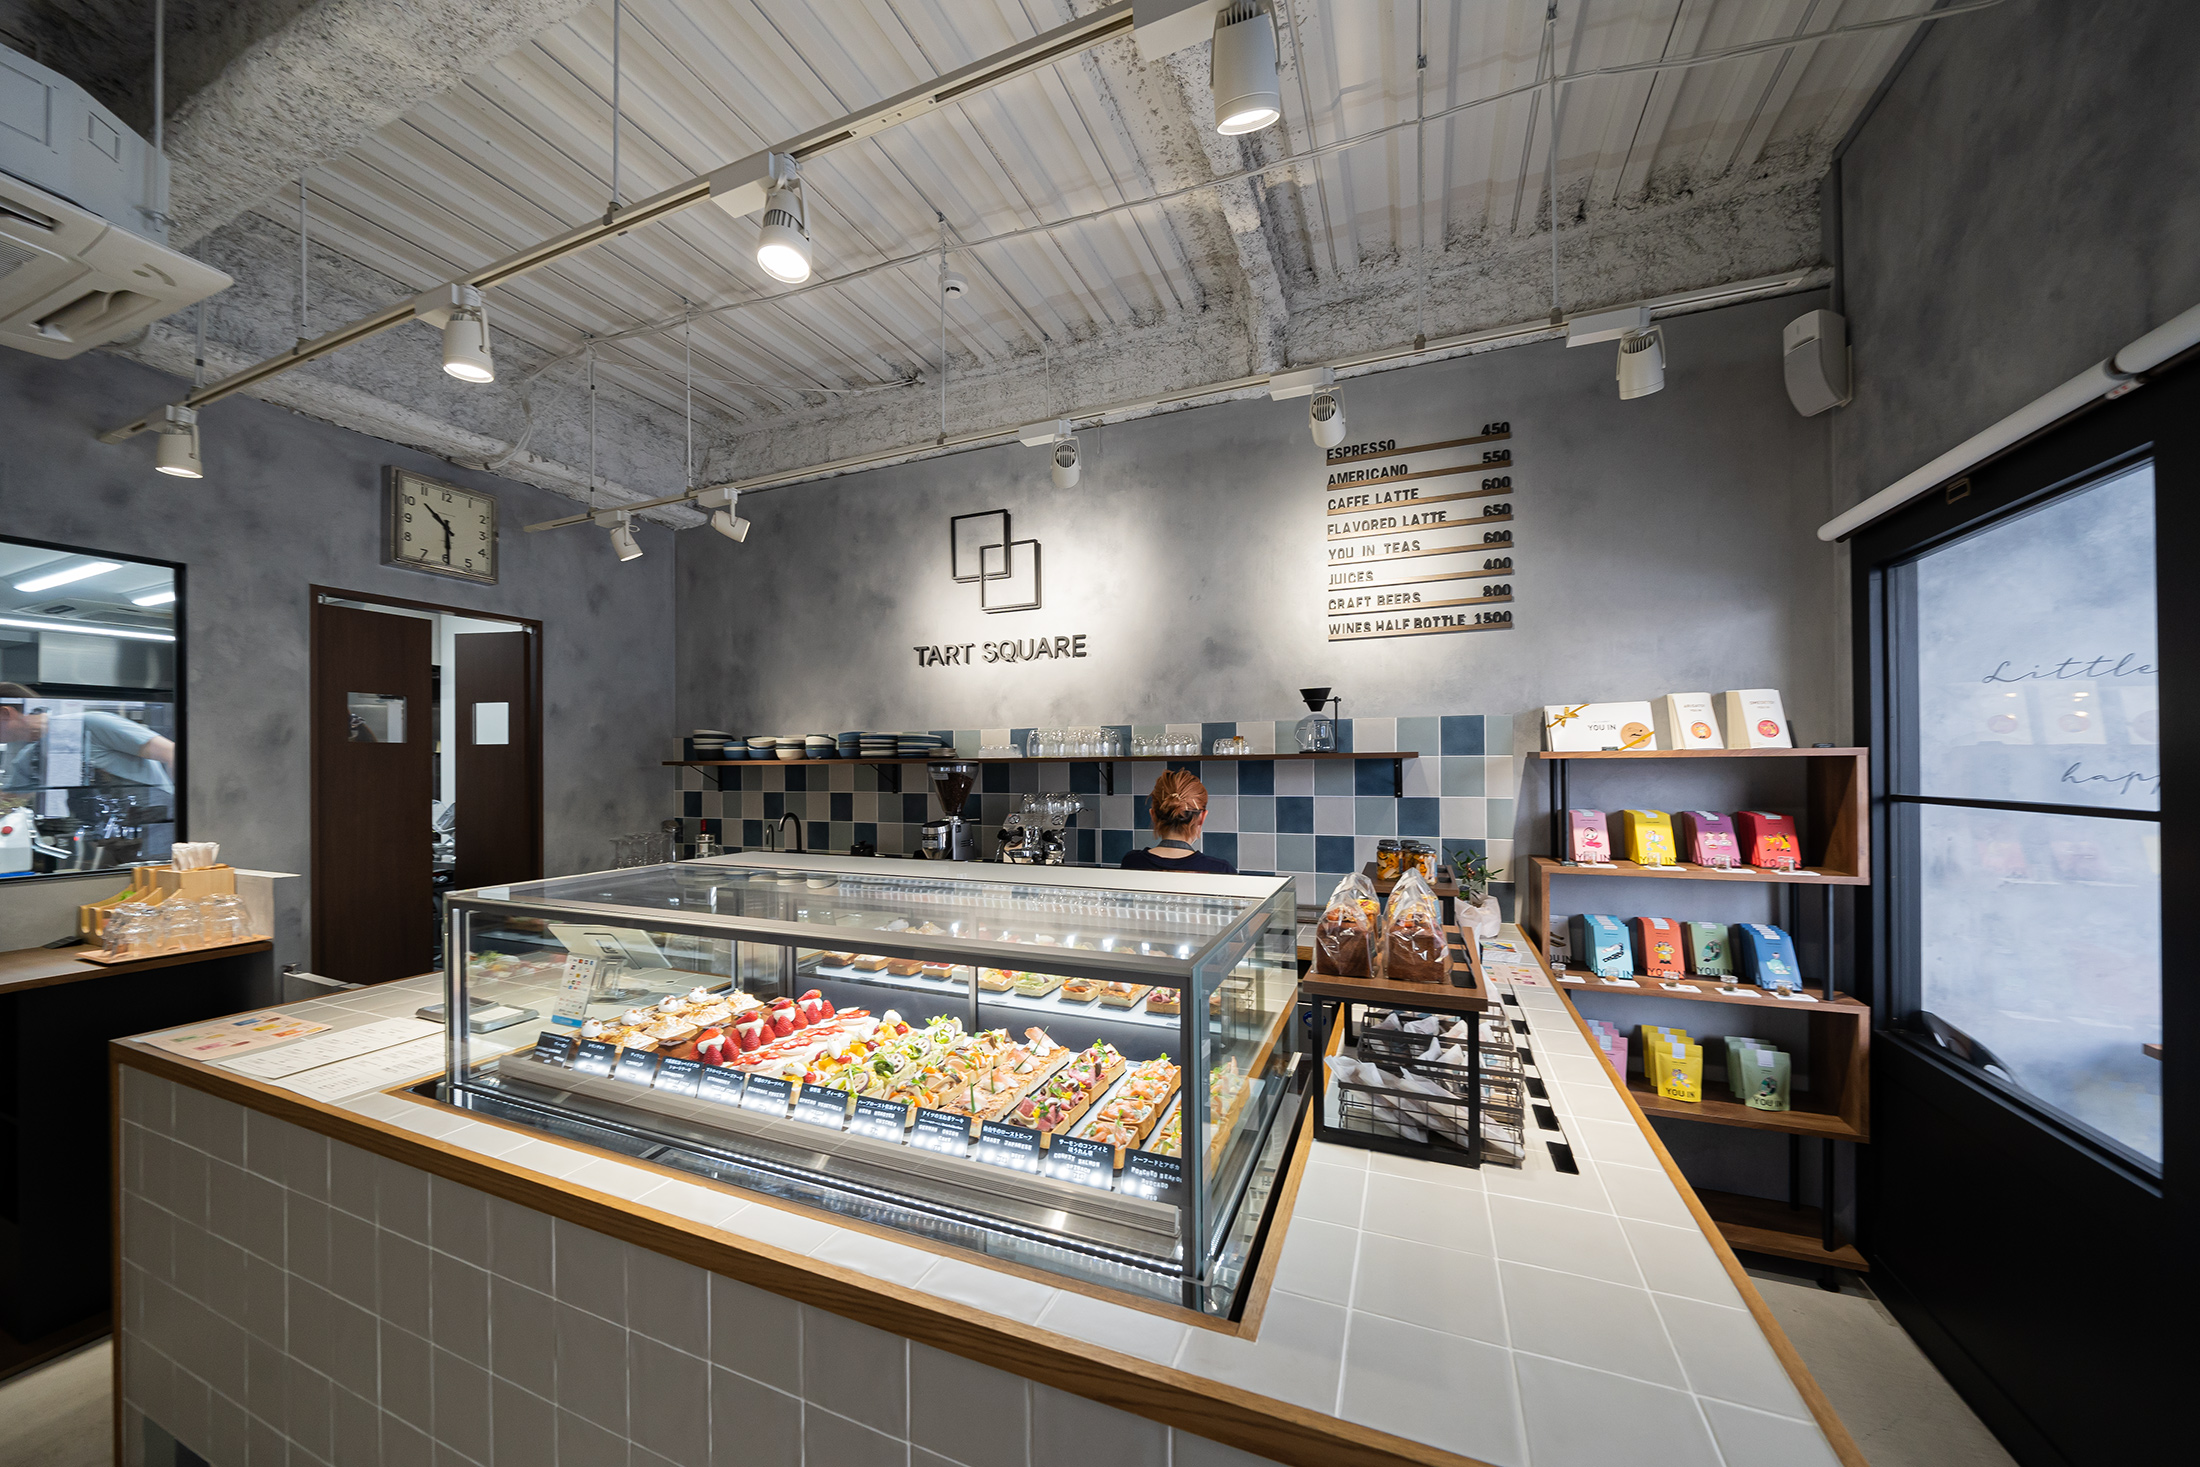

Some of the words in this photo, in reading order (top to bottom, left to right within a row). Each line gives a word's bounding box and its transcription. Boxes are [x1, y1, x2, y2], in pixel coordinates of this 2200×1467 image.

[1327, 439, 1396, 460] ESPRESSO
[1481, 421, 1510, 436] 450
[1327, 463, 1408, 486] AMERICANO
[1482, 449, 1511, 464] 550
[420, 487, 428, 496] 11
[441, 492, 452, 503] 12
[1328, 494, 1370, 511] CAFFE
[1376, 488, 1419, 504] LATTE
[1481, 476, 1511, 491] 600
[402, 493, 415, 506] 10
[404, 513, 412, 523] 9
[479, 515, 486, 524] 2
[1327, 516, 1397, 536] FLAVORED
[1402, 510, 1447, 527] LATTE
[1483, 503, 1512, 518] 650
[404, 532, 412, 541] 8
[479, 531, 486, 541] 3
[1328, 547, 1354, 561] YOU
[1362, 545, 1375, 557] IN
[1384, 540, 1420, 554] TEAS
[1483, 530, 1512, 544] 600
[420, 548, 428, 558] 7
[477, 549, 486, 558] 4
[464, 558, 473, 568] 5
[1328, 570, 1374, 586] JUICES
[1483, 556, 1512, 570] 400
[1328, 596, 1371, 611] CRAFT
[1377, 592, 1421, 606] BEERS
[1483, 584, 1512, 597] 800
[1328, 621, 1372, 636] WINES
[1376, 618, 1411, 632] HALF
[1413, 614, 1466, 629] BOTTLE
[1474, 610, 1512, 625] 1500
[913, 643, 975, 668] TART
[981, 634, 1087, 663] SQUARE
[1981, 652, 2159, 684] Little
[1697, 967, 1719, 976] YOU
[1665, 1088, 1685, 1097] YOU
[1752, 1096, 1773, 1107] YOU
[982, 1135, 1001, 1145] ROAST
[1004, 1139, 1033, 1151] JAPANESE
[1059, 1138, 1108, 1153] サーモンのコンフィと
[1053, 1152, 1076, 1162] CONFIT
[1078, 1158, 1101, 1168] SALMON
[1131, 1166, 1158, 1178] POACHED
[1141, 1178, 1169, 1189] AVOCADO
